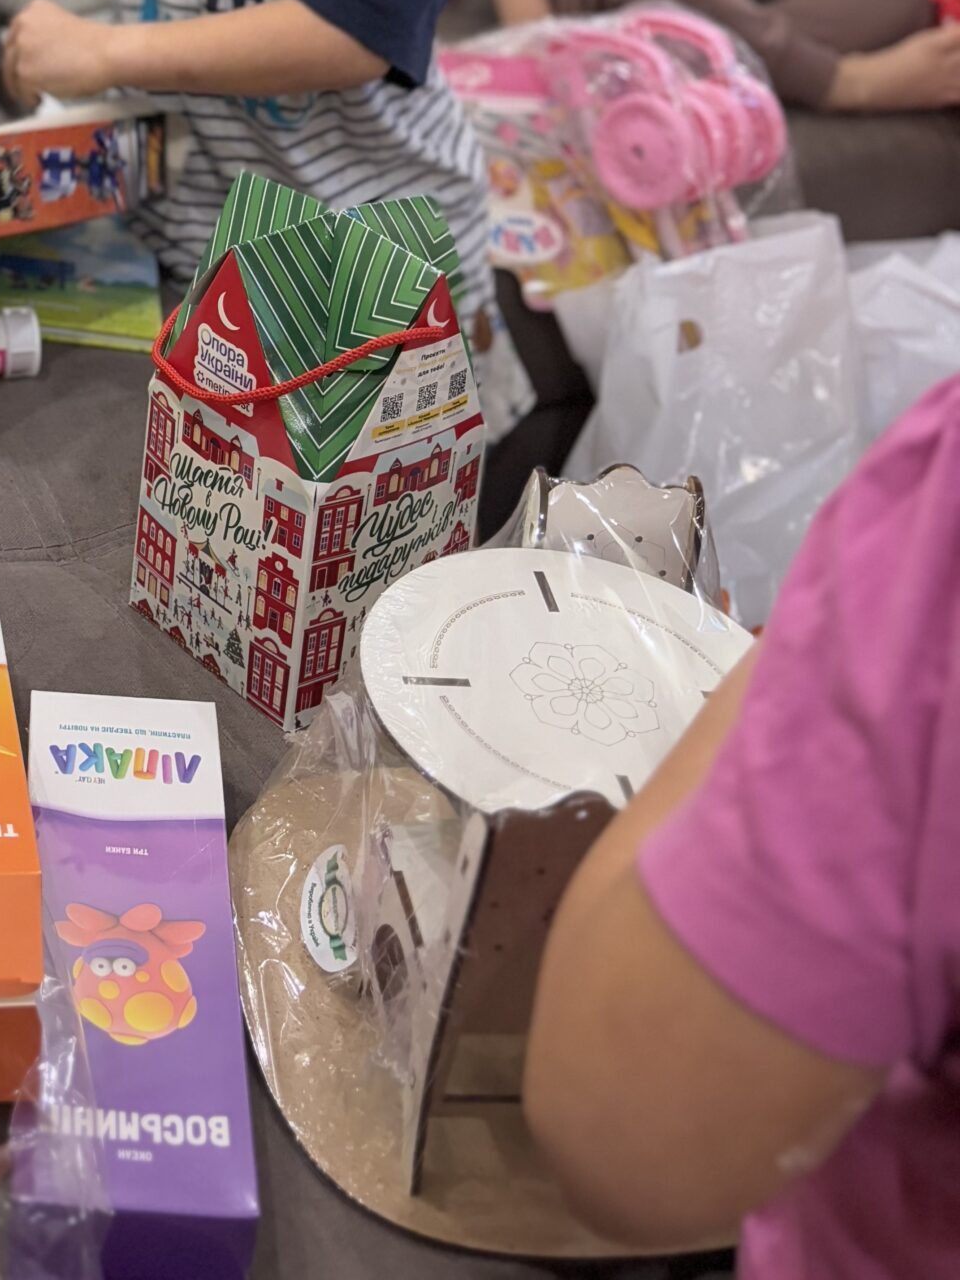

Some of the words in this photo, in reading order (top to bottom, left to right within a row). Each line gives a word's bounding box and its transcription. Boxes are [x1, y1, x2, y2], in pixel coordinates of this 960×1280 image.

[200, 328, 245, 368] Опора
[201, 345, 253, 392] України
[170, 452, 244, 498] Щастя
[153, 476, 219, 537] Новому
[220, 502, 274, 551] Році!
[351, 491, 435, 559] Чудес
[338, 490, 461, 602] подарунків!
[90, 725, 101, 733] НА
[49, 742, 202, 785] ЛІПАКА
[133, 847, 149, 856] ТРИ
[117, 1149, 153, 1162] ОКЕАН
